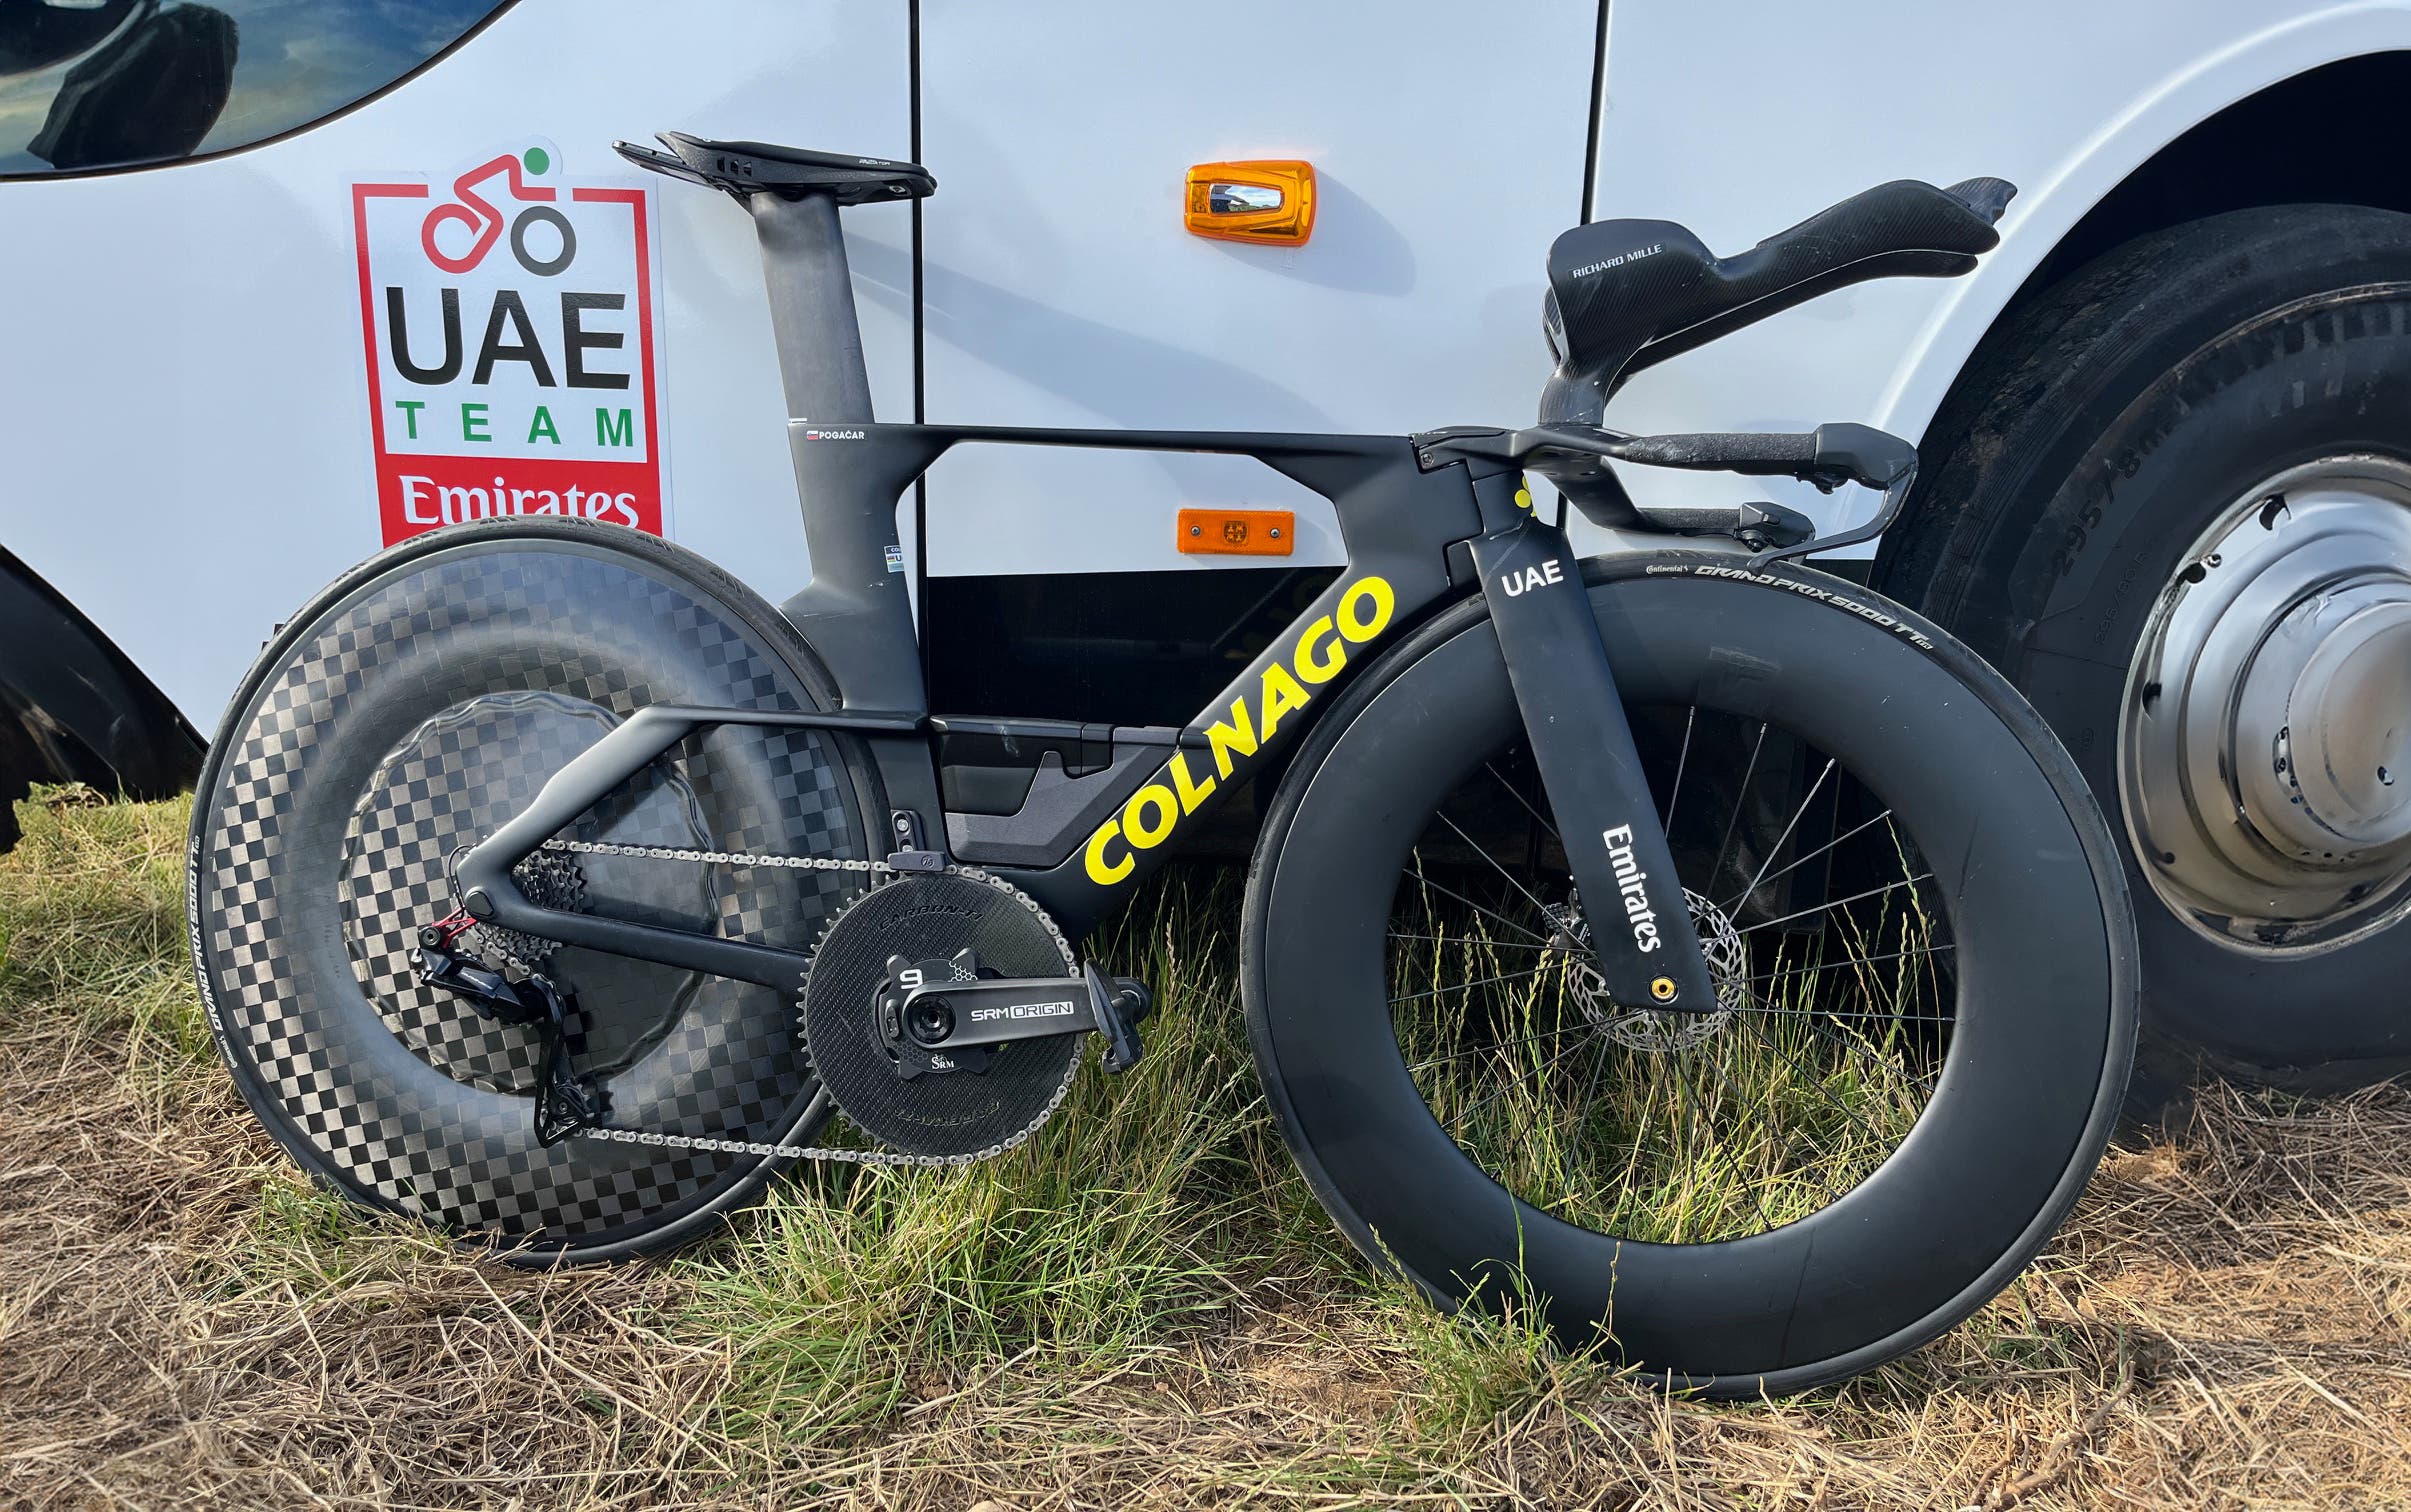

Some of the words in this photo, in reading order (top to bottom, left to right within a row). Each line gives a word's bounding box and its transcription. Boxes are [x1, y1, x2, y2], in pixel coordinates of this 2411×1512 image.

[1572, 255, 1624, 279] RICHARD
[1626, 244, 1663, 262] MILLE
[386, 286, 632, 390] UAE
[395, 401, 634, 447] TEAM
[818, 430, 865, 440] POGAČAR
[398, 475, 640, 530] Emirates
[1501, 559, 1564, 598] UAE
[1646, 564, 1683, 575] Continental
[1694, 565, 1776, 584] GRAND
[1774, 579, 1832, 600] PRIX
[1829, 596, 1897, 626] 5000
[1085, 576, 1395, 885] COLNAGO
[189, 872, 200, 924] 5000
[1603, 823, 1661, 953] Emirates
[191, 924, 207, 970] PRIX
[199, 970, 224, 1031] GRAND
[899, 968, 923, 990] 9
[971, 1007, 1010, 1021] SRM
[1010, 1002, 1074, 1019] ORIGIN
[931, 1056, 955, 1070] SRM
